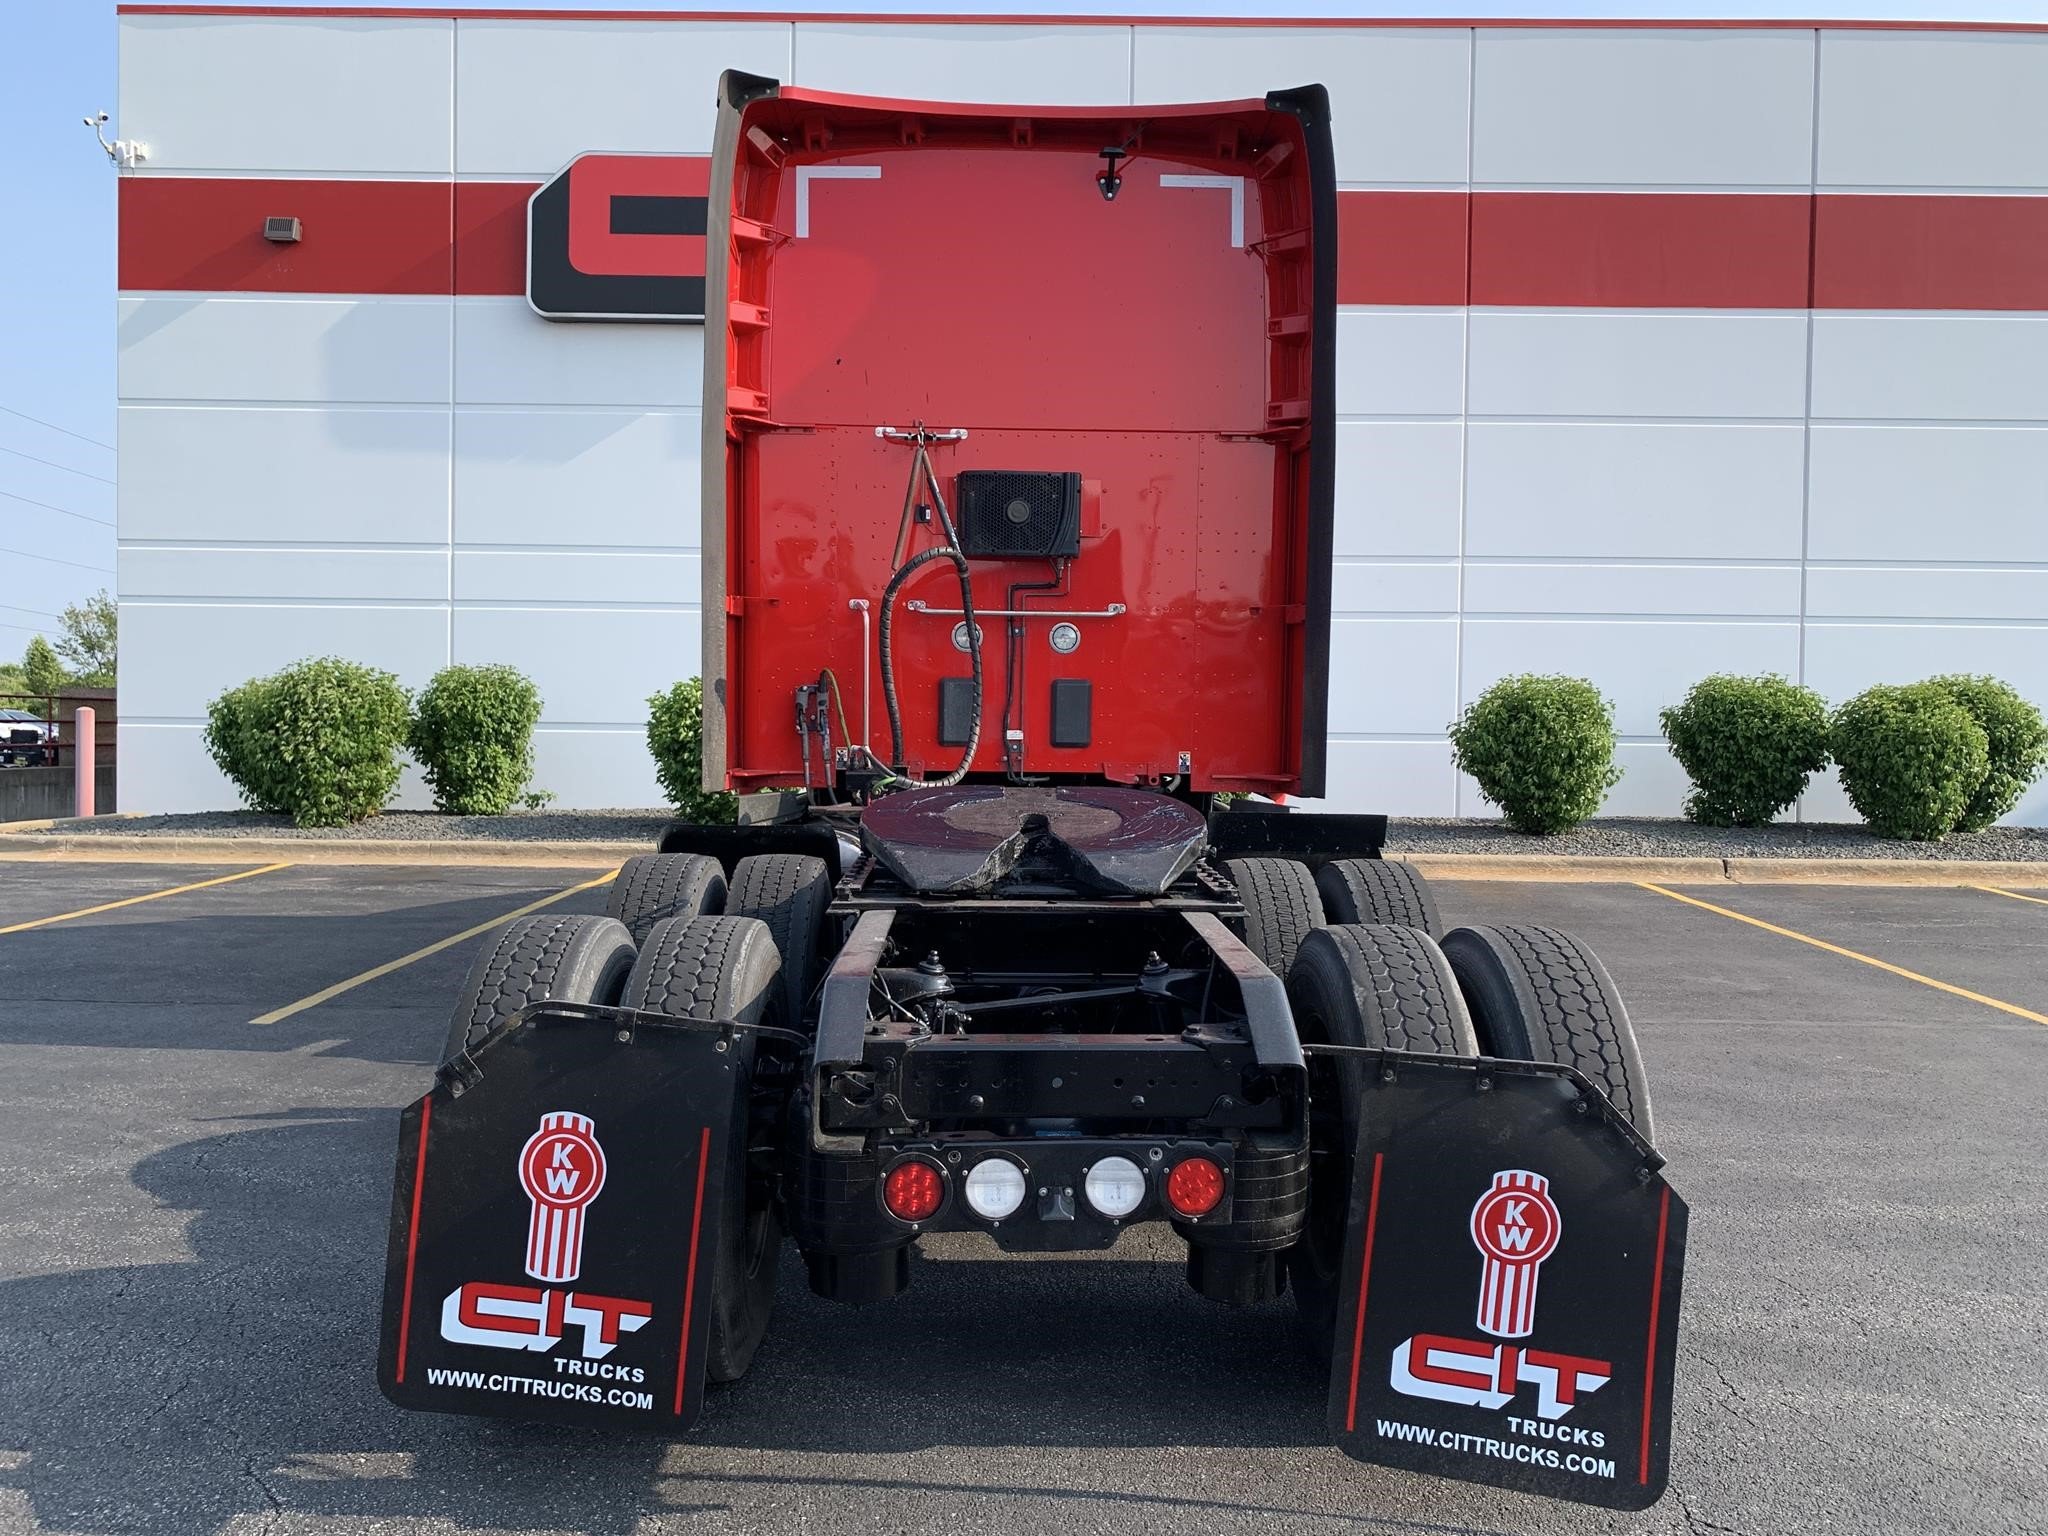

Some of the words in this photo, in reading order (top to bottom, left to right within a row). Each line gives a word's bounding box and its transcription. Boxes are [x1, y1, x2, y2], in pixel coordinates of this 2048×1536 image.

[440, 1281, 653, 1360] CIT
[427, 1367, 653, 1410] WWW.CITTRUCKS.COM
[553, 1357, 645, 1383] TRUCKS
[1390, 1333, 1612, 1421] CIT
[1376, 1418, 1615, 1479] WWW.CITTRUCKS.COM
[1507, 1415, 1605, 1449] TRUCKS
